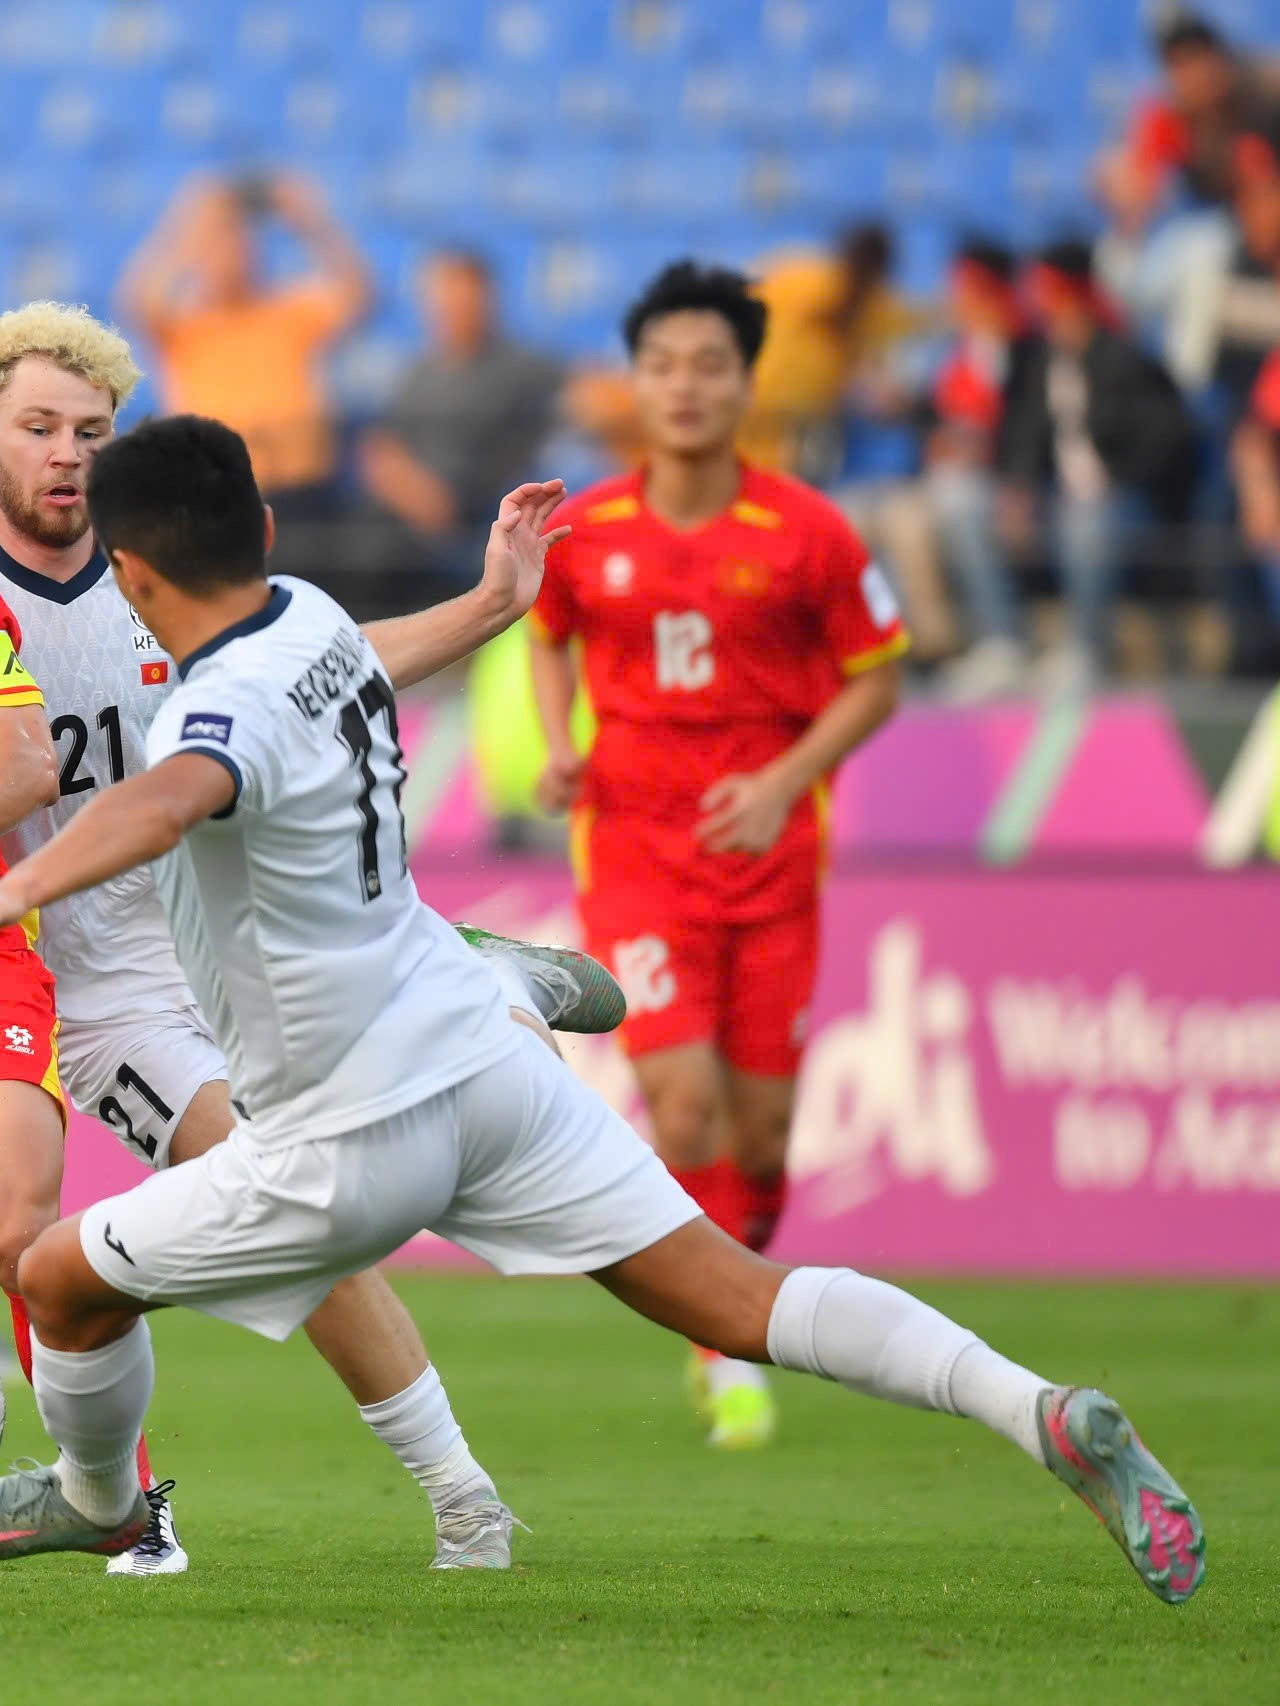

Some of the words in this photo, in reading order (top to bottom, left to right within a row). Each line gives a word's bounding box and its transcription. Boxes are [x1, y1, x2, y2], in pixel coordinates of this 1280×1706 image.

[133, 635, 157, 651] KF
[654, 609, 715, 691] 12
[49, 704, 125, 797] 21
[98, 1062, 175, 1161] 21
